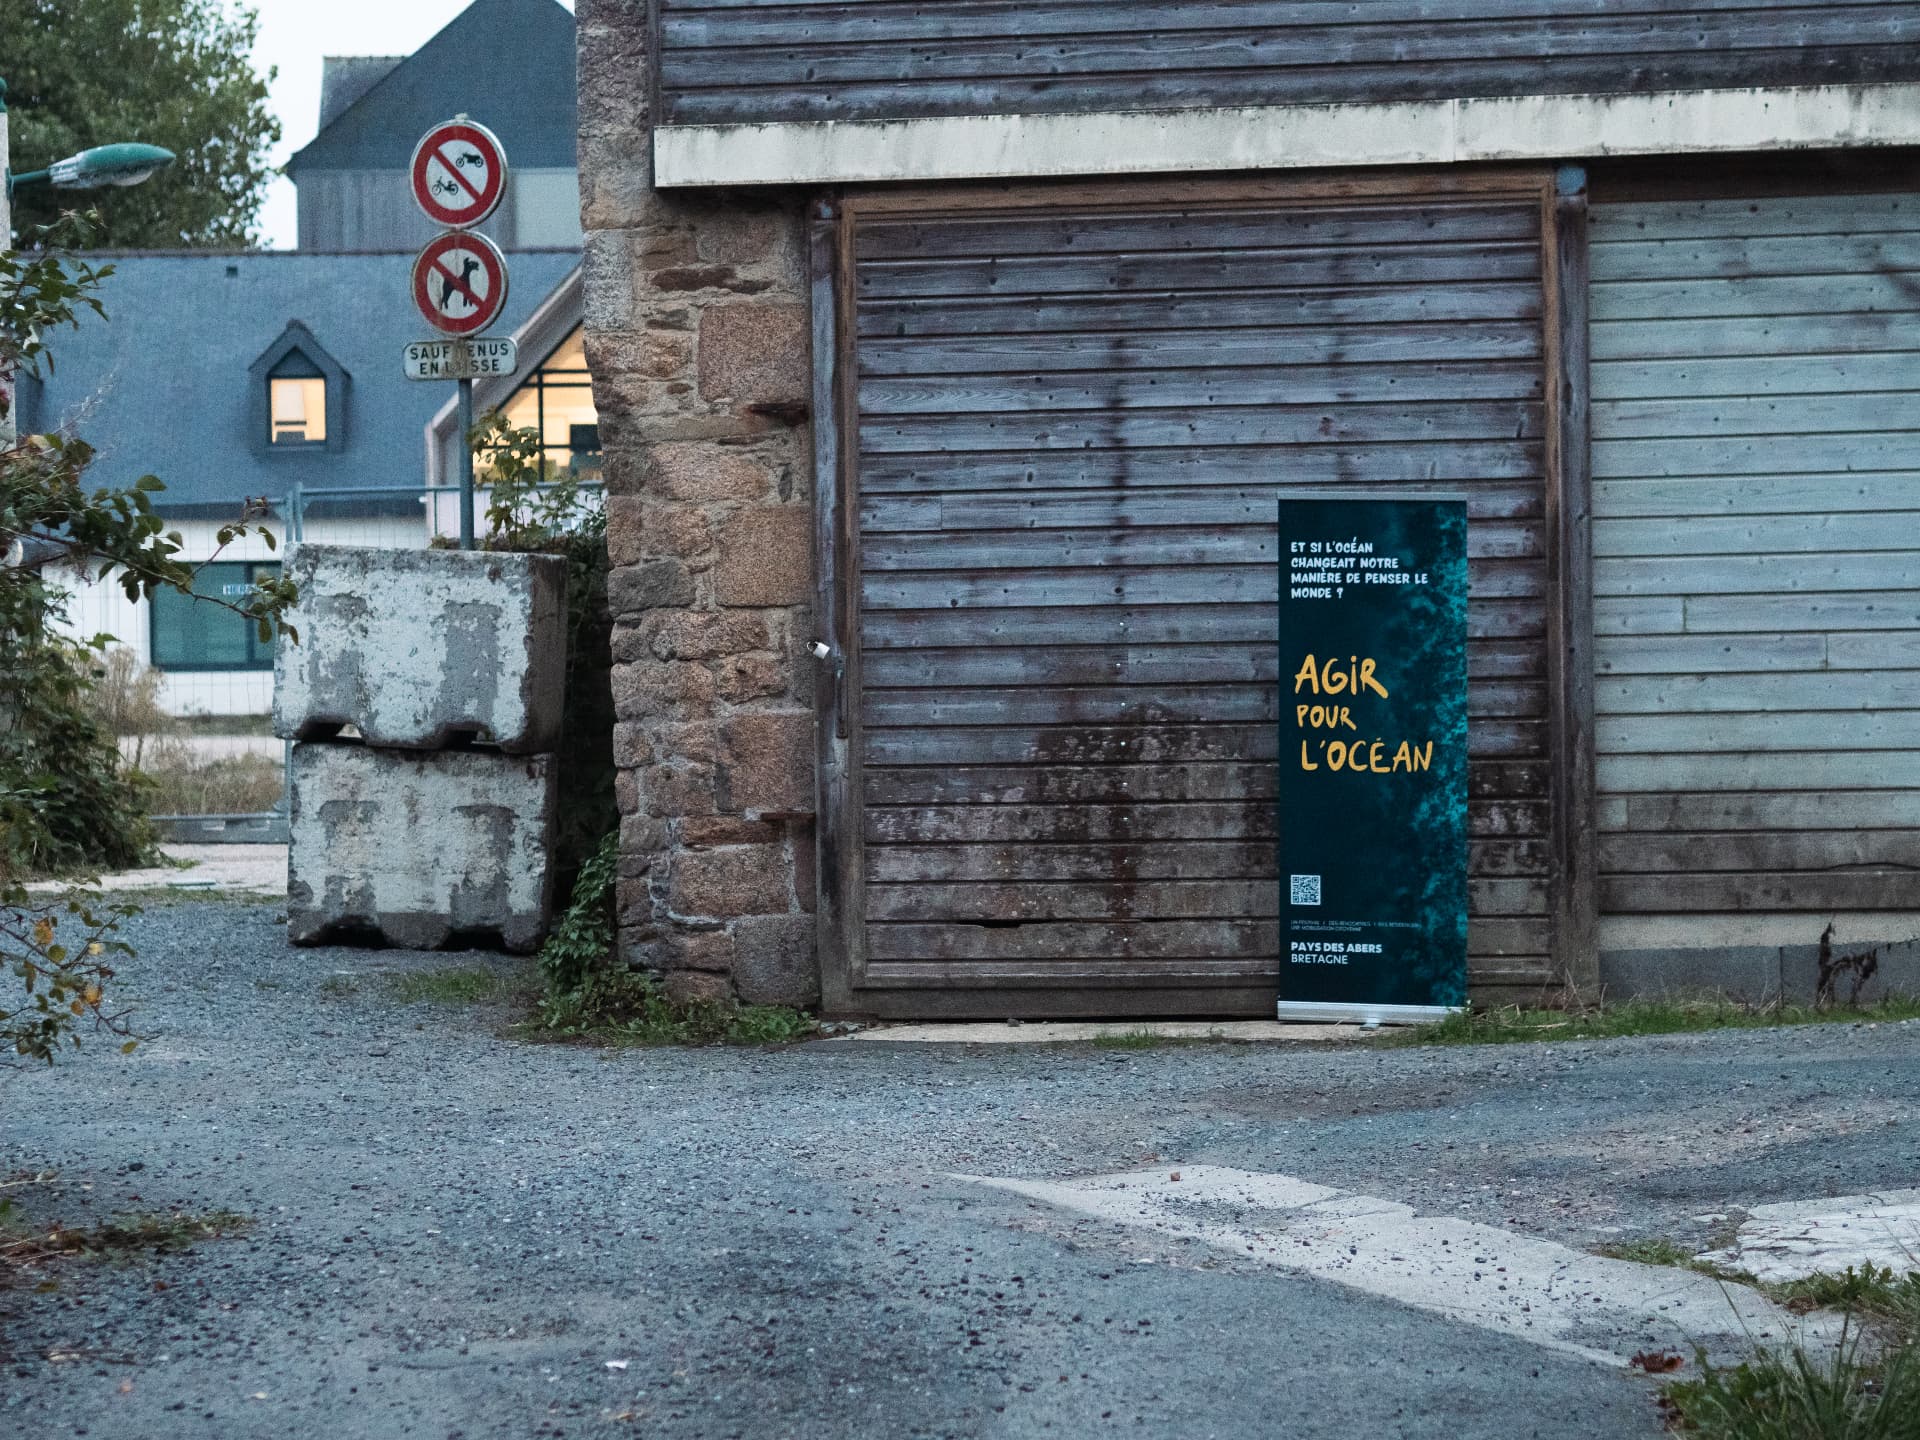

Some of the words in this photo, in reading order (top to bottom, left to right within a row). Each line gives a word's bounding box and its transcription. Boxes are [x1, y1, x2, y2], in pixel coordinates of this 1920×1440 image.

[410, 346, 450, 360] SAUF
[420, 362, 439, 375] EN
[445, 359, 500, 373] LSSE
[1290, 541, 1306, 553] ET
[1310, 542, 1322, 553] SI
[1326, 536, 1373, 553] L'OCÉAN
[1290, 557, 1356, 569] CHANGEAIT
[1360, 557, 1399, 569] NOTRE
[1290, 568, 1342, 584] MANIÈRE
[1346, 573, 1360, 584] DE
[1365, 573, 1410, 584] PENSER
[1415, 573, 1428, 584] LE
[1290, 587, 1332, 599] MONDE
[1296, 704, 1357, 731] POUR
[1301, 737, 1434, 773] L'OCÉAN
[1290, 941, 1321, 952] PAYS
[1323, 942, 1344, 952] DES
[1346, 943, 1383, 954] ABERS
[1290, 953, 1348, 965] BRETAGNE
